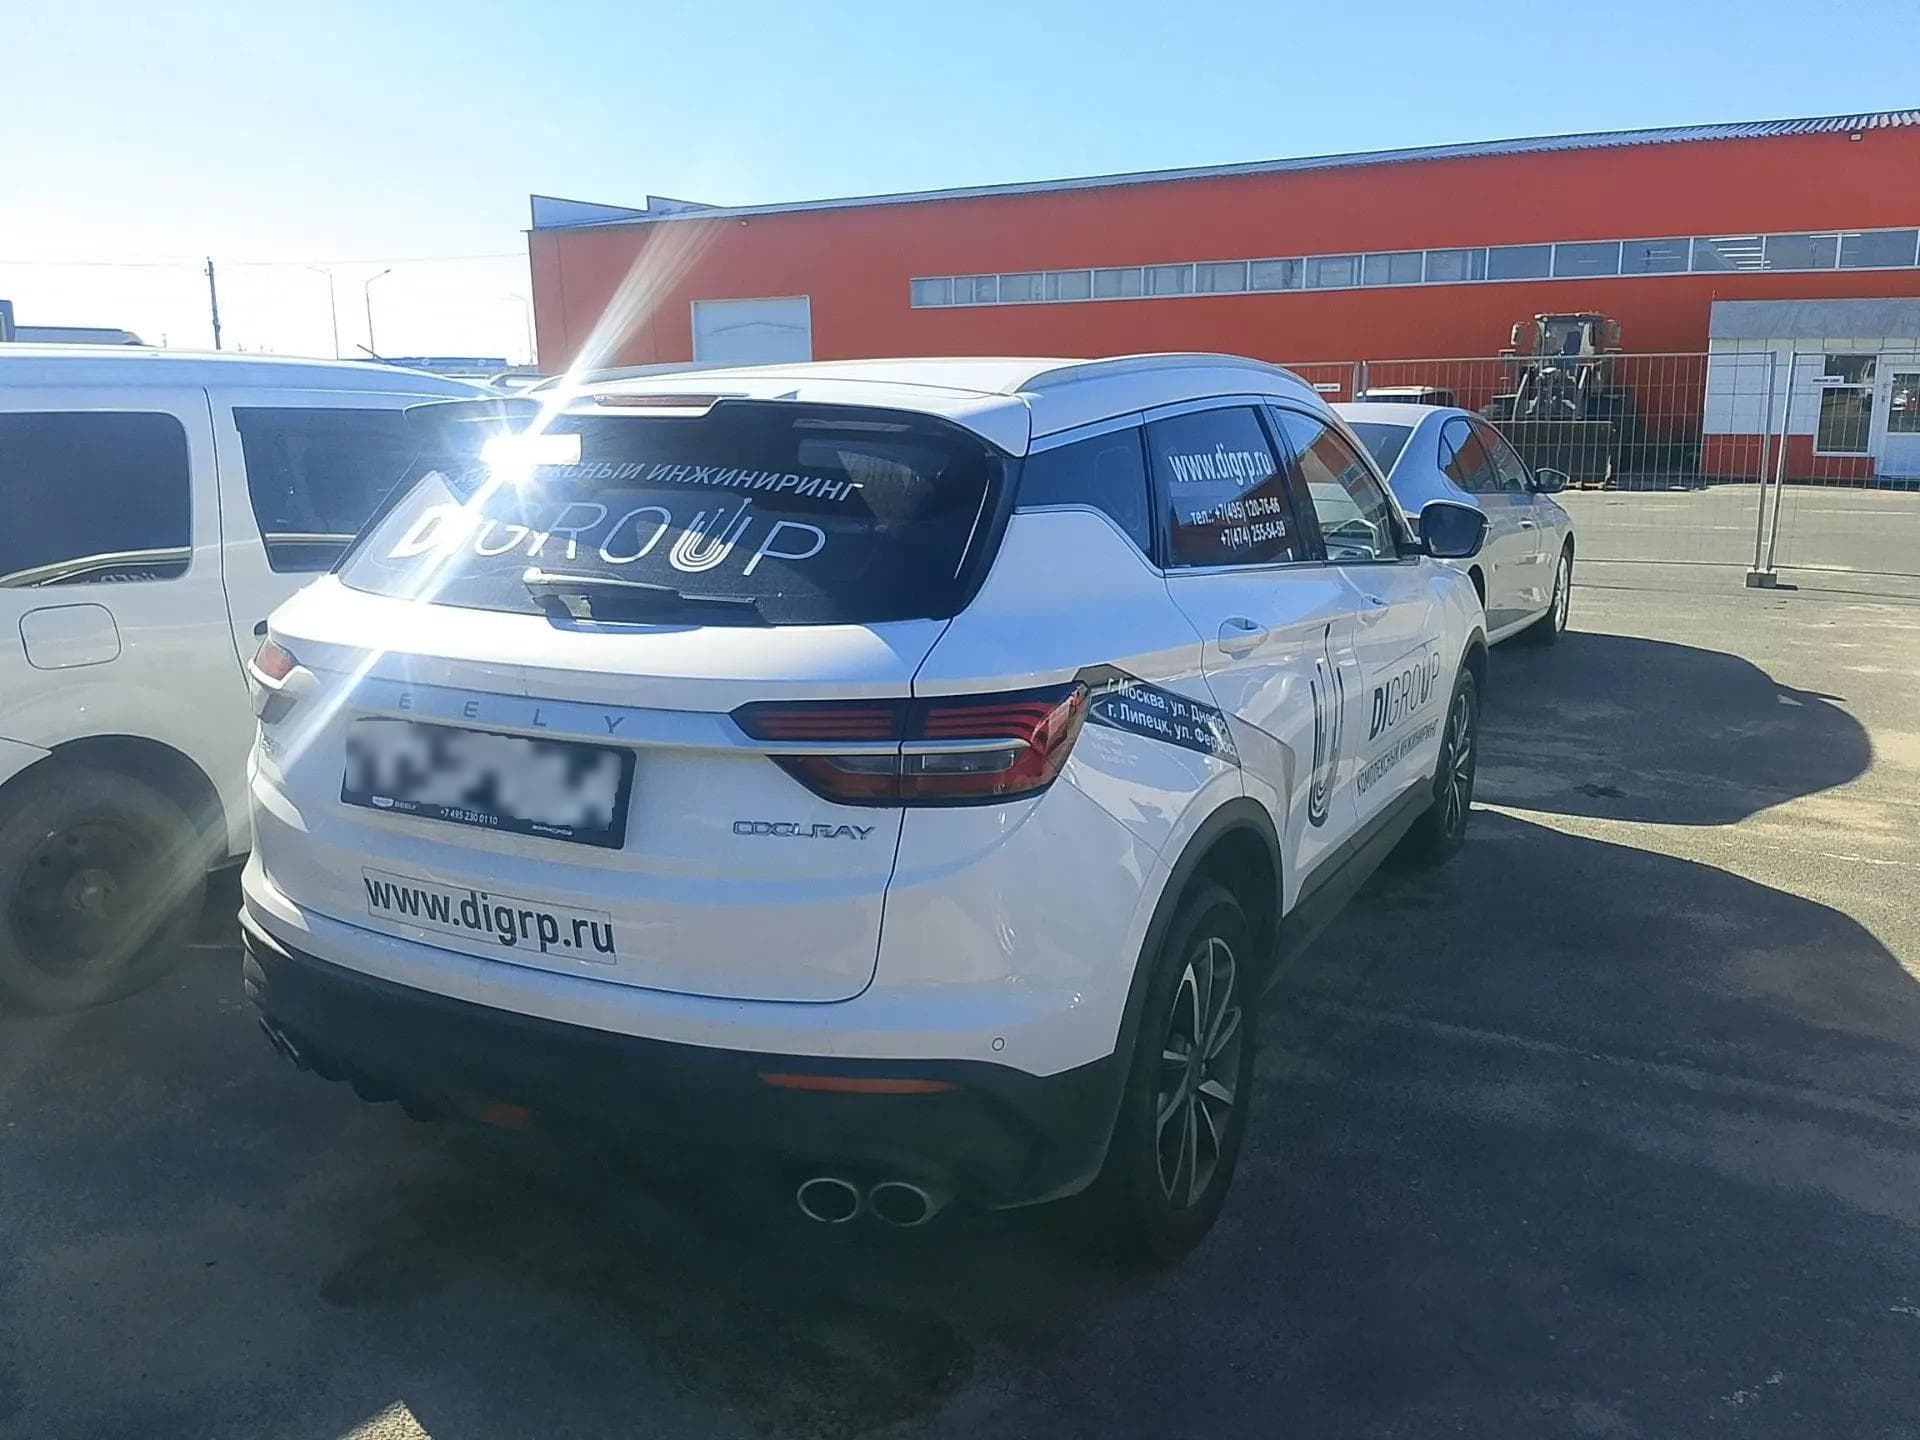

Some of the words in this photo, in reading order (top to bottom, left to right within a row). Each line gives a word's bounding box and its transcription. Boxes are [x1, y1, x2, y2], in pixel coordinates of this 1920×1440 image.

[646, 463, 864, 501] ИНЖИНИРИНГ
[1168, 443, 1272, 486] www.digrp.ru
[1118, 678, 1169, 712] Москва,
[1170, 702, 1190, 718] ул.
[1107, 703, 1117, 718] г.
[1120, 703, 1172, 736] Липецк,
[1173, 723, 1194, 740] ул.
[450, 809, 464, 820] 495
[464, 811, 479, 823] 230
[363, 877, 615, 953] www.digrp.ru
